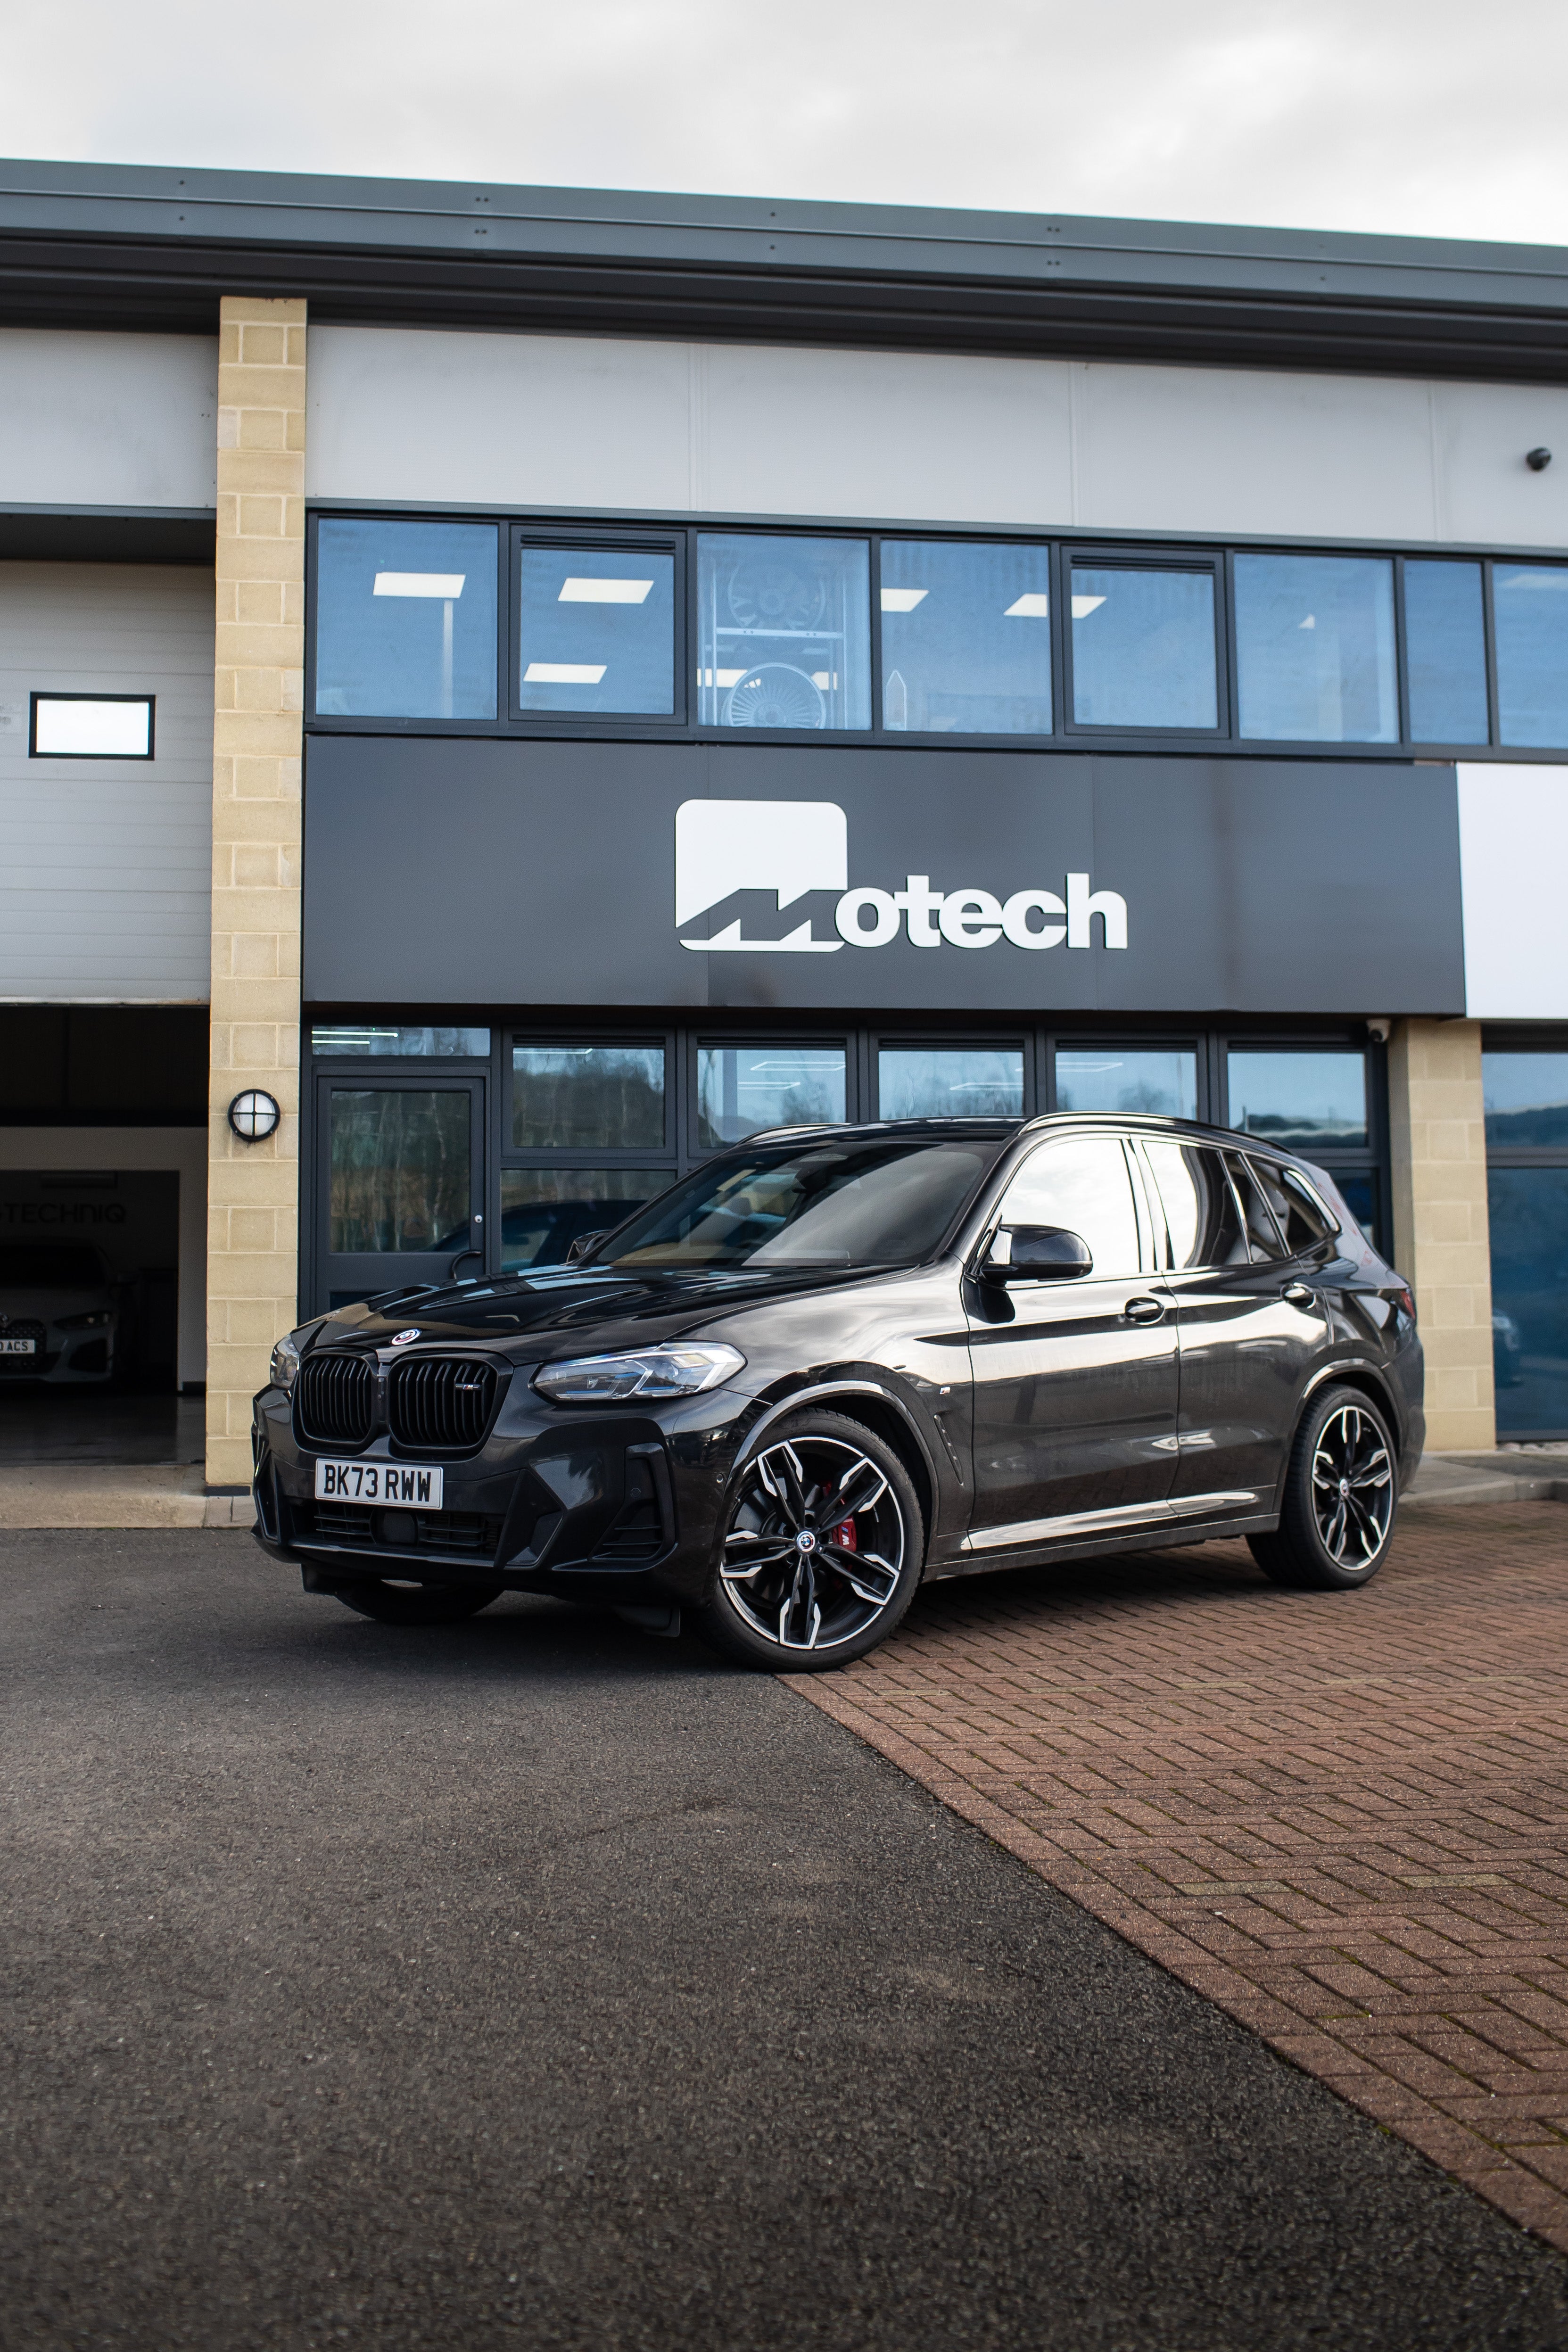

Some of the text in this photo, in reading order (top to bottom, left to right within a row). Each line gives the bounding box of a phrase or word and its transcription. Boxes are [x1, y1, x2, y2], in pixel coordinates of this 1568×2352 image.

[7, 1341, 29, 1351] ACS
[324, 1464, 431, 1502] BK73 RWW
